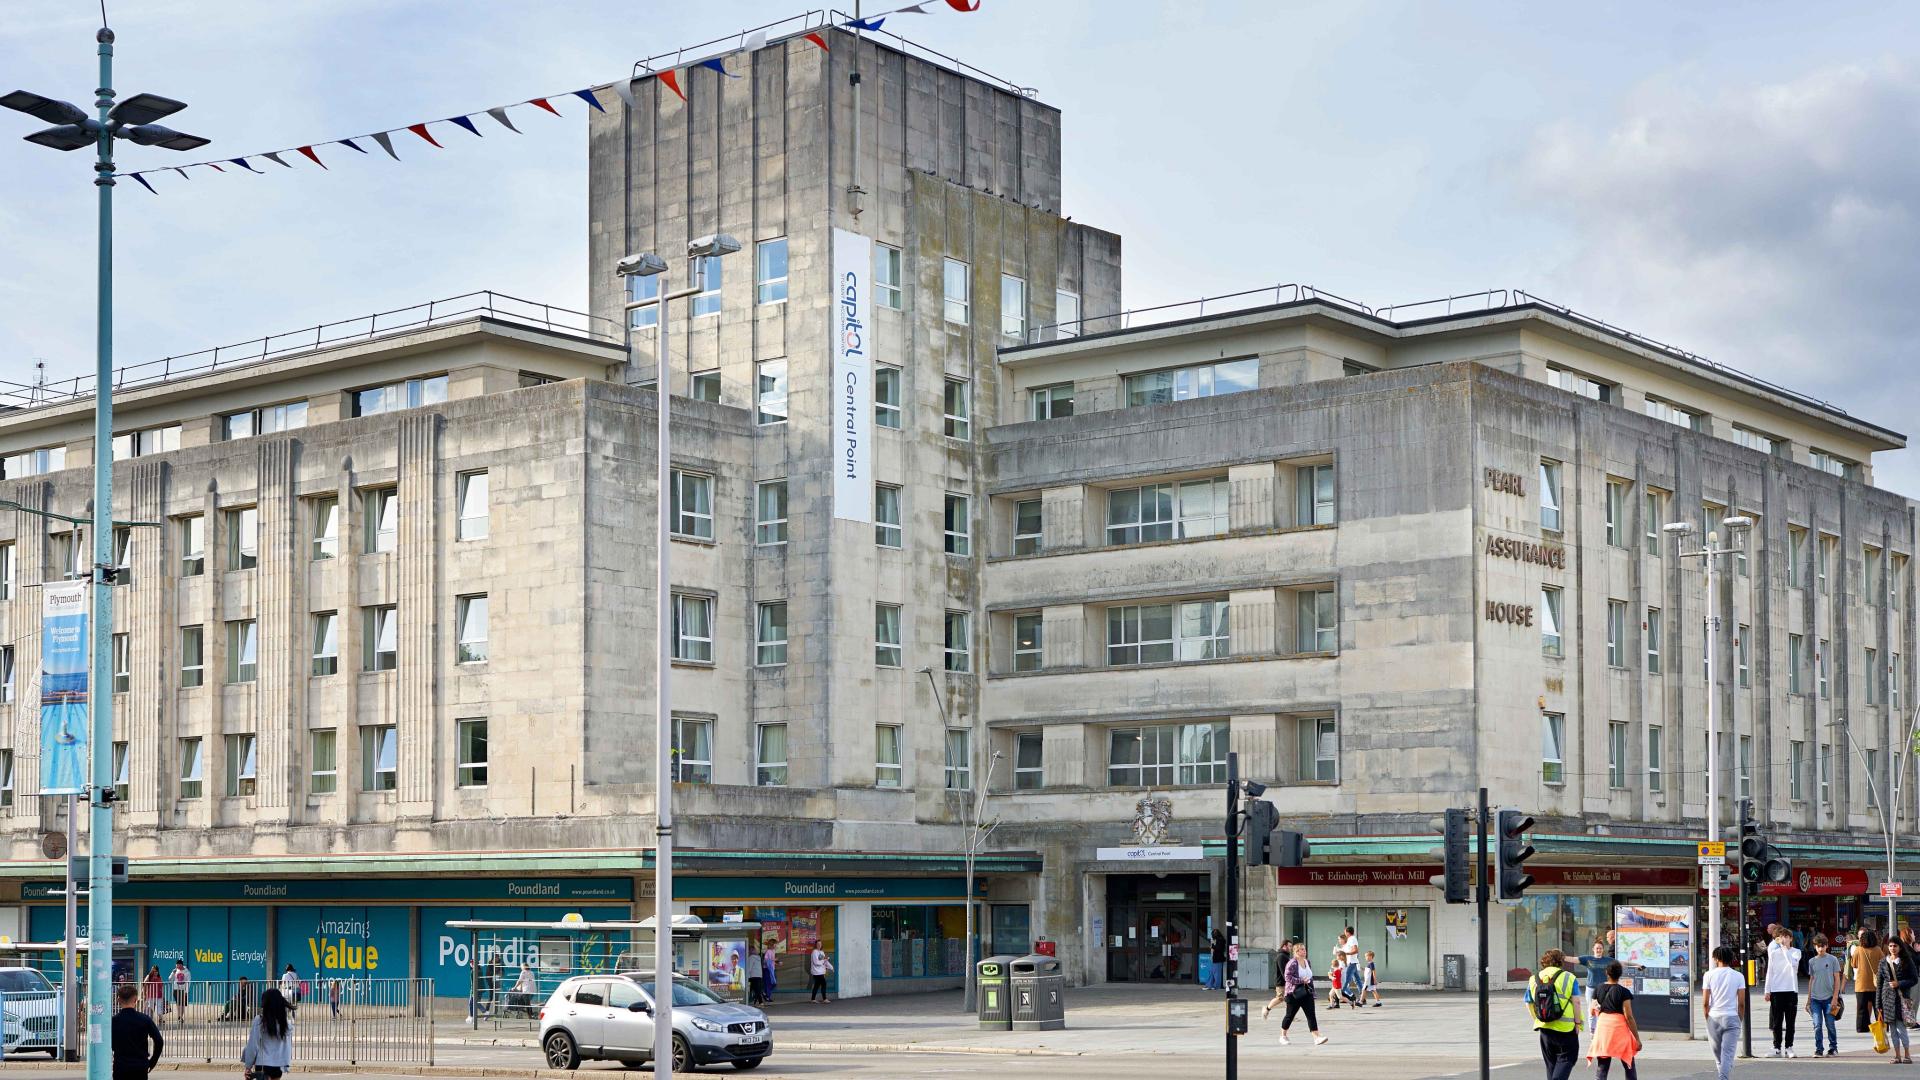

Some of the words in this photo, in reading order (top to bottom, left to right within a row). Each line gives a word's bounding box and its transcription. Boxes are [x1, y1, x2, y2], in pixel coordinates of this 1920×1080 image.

[846, 371, 857, 435] Central
[846, 438, 857, 480] Point
[1484, 467, 1525, 497] PEARL
[1485, 535, 1566, 569] ASSURANCE
[50, 593, 82, 606] Plymouth
[1485, 600, 1534, 628] HOUSE
[1309, 871, 1324, 881] The
[1328, 871, 1369, 883] Edinburgh
[1372, 871, 1404, 881] Woollen
[1408, 870, 1425, 881] Mill
[1813, 876, 1843, 888] EXCHANGE
[244, 884, 287, 896] Poundland
[508, 882, 560, 895] Poundland
[784, 881, 835, 894] Poundland
[317, 918, 370, 938] Amazing
[153, 948, 184, 962] Amazing
[195, 949, 224, 963] Value
[231, 949, 267, 965] Everyday!
[308, 937, 379, 970] Value
[439, 935, 540, 968] Poundla
